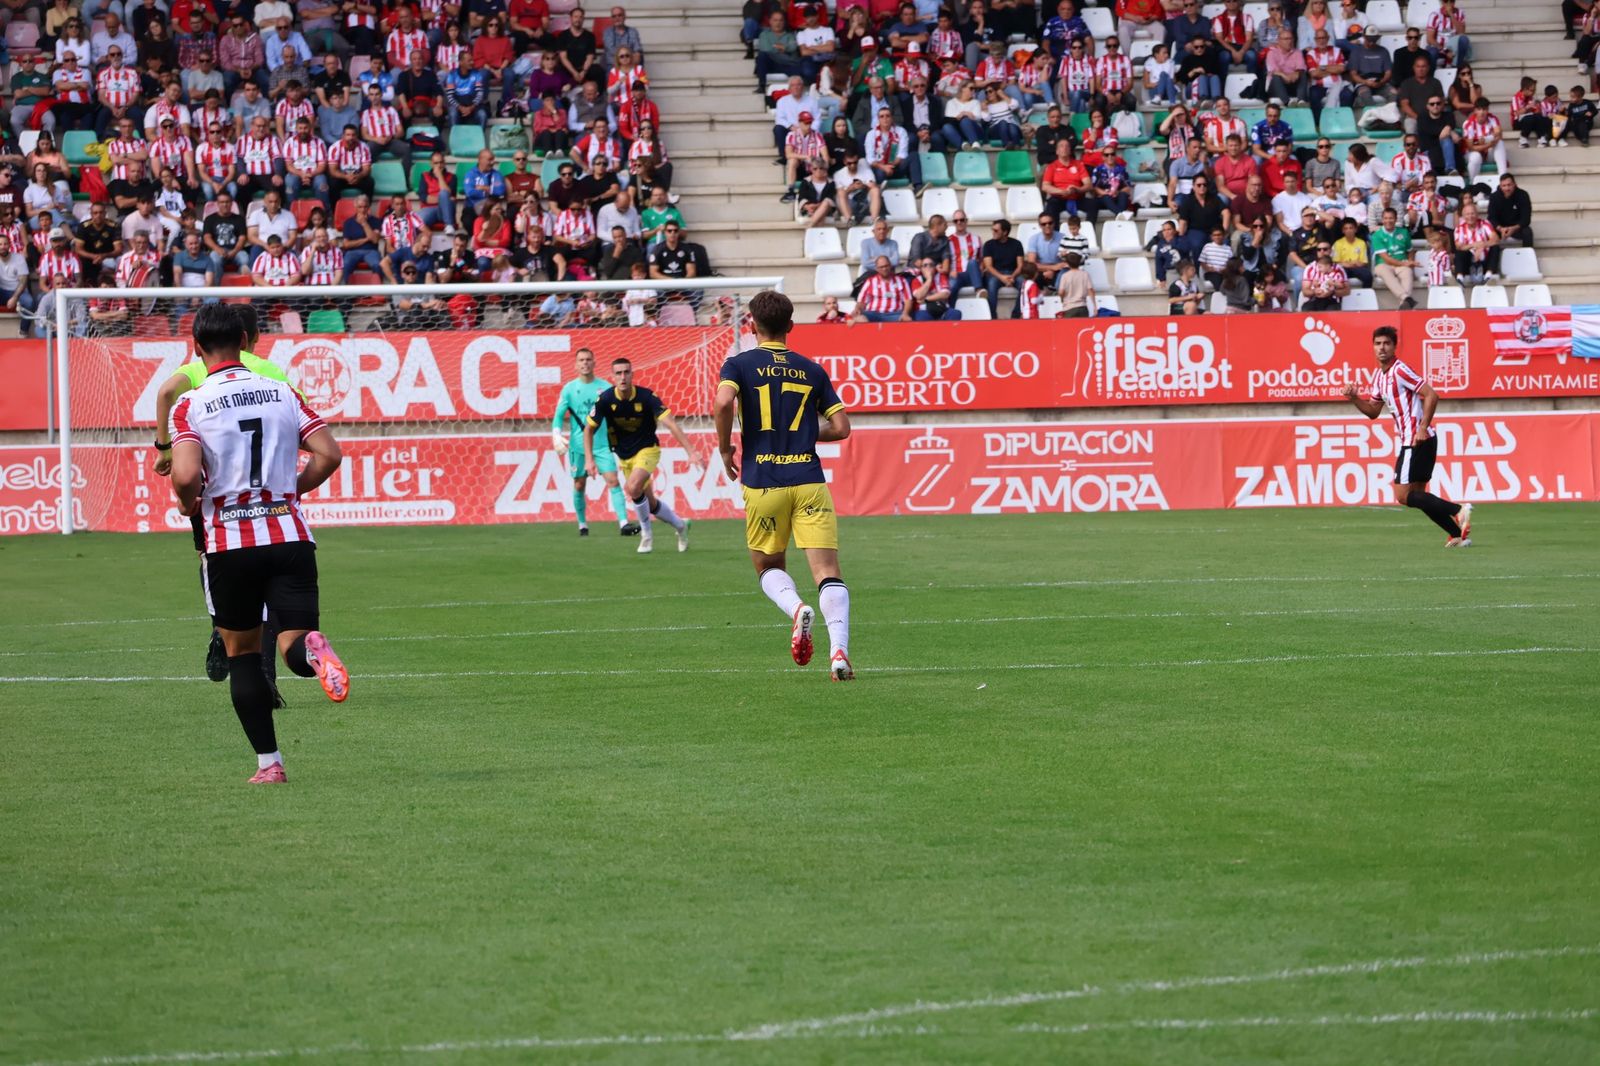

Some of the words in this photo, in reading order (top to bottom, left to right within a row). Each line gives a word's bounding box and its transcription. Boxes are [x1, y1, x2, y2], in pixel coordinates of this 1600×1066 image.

[812, 353, 896, 382] TRO
[905, 345, 1040, 380] ÓPTICO
[1103, 322, 1215, 373] fisio
[461, 335, 571, 415] CF
[756, 364, 807, 380] VÍCTOR
[1106, 358, 1233, 397] readapt
[1248, 361, 1379, 398] podoactiv
[1491, 373, 1600, 391] AYUNTAMIE
[231, 388, 282, 407] MÁRQUEZ
[754, 382, 813, 432] 17
[836, 379, 976, 408] OBERTO
[1107, 389, 1195, 400] POLICLÍNICA
[1267, 385, 1320, 398] PODOLOGÍA
[1321, 387, 1328, 396] Y
[238, 417, 263, 488] 7
[382, 446, 418, 464] del
[1294, 421, 1518, 460] PERSINAS
[0, 456, 88, 490] ela
[133, 450, 150, 533] vinos
[1234, 460, 1522, 507] ZAMORNAS
[1528, 474, 1582, 501] S.L.
[219, 503, 290, 520] leomotor.net
[970, 473, 1170, 514] ZAMORA
